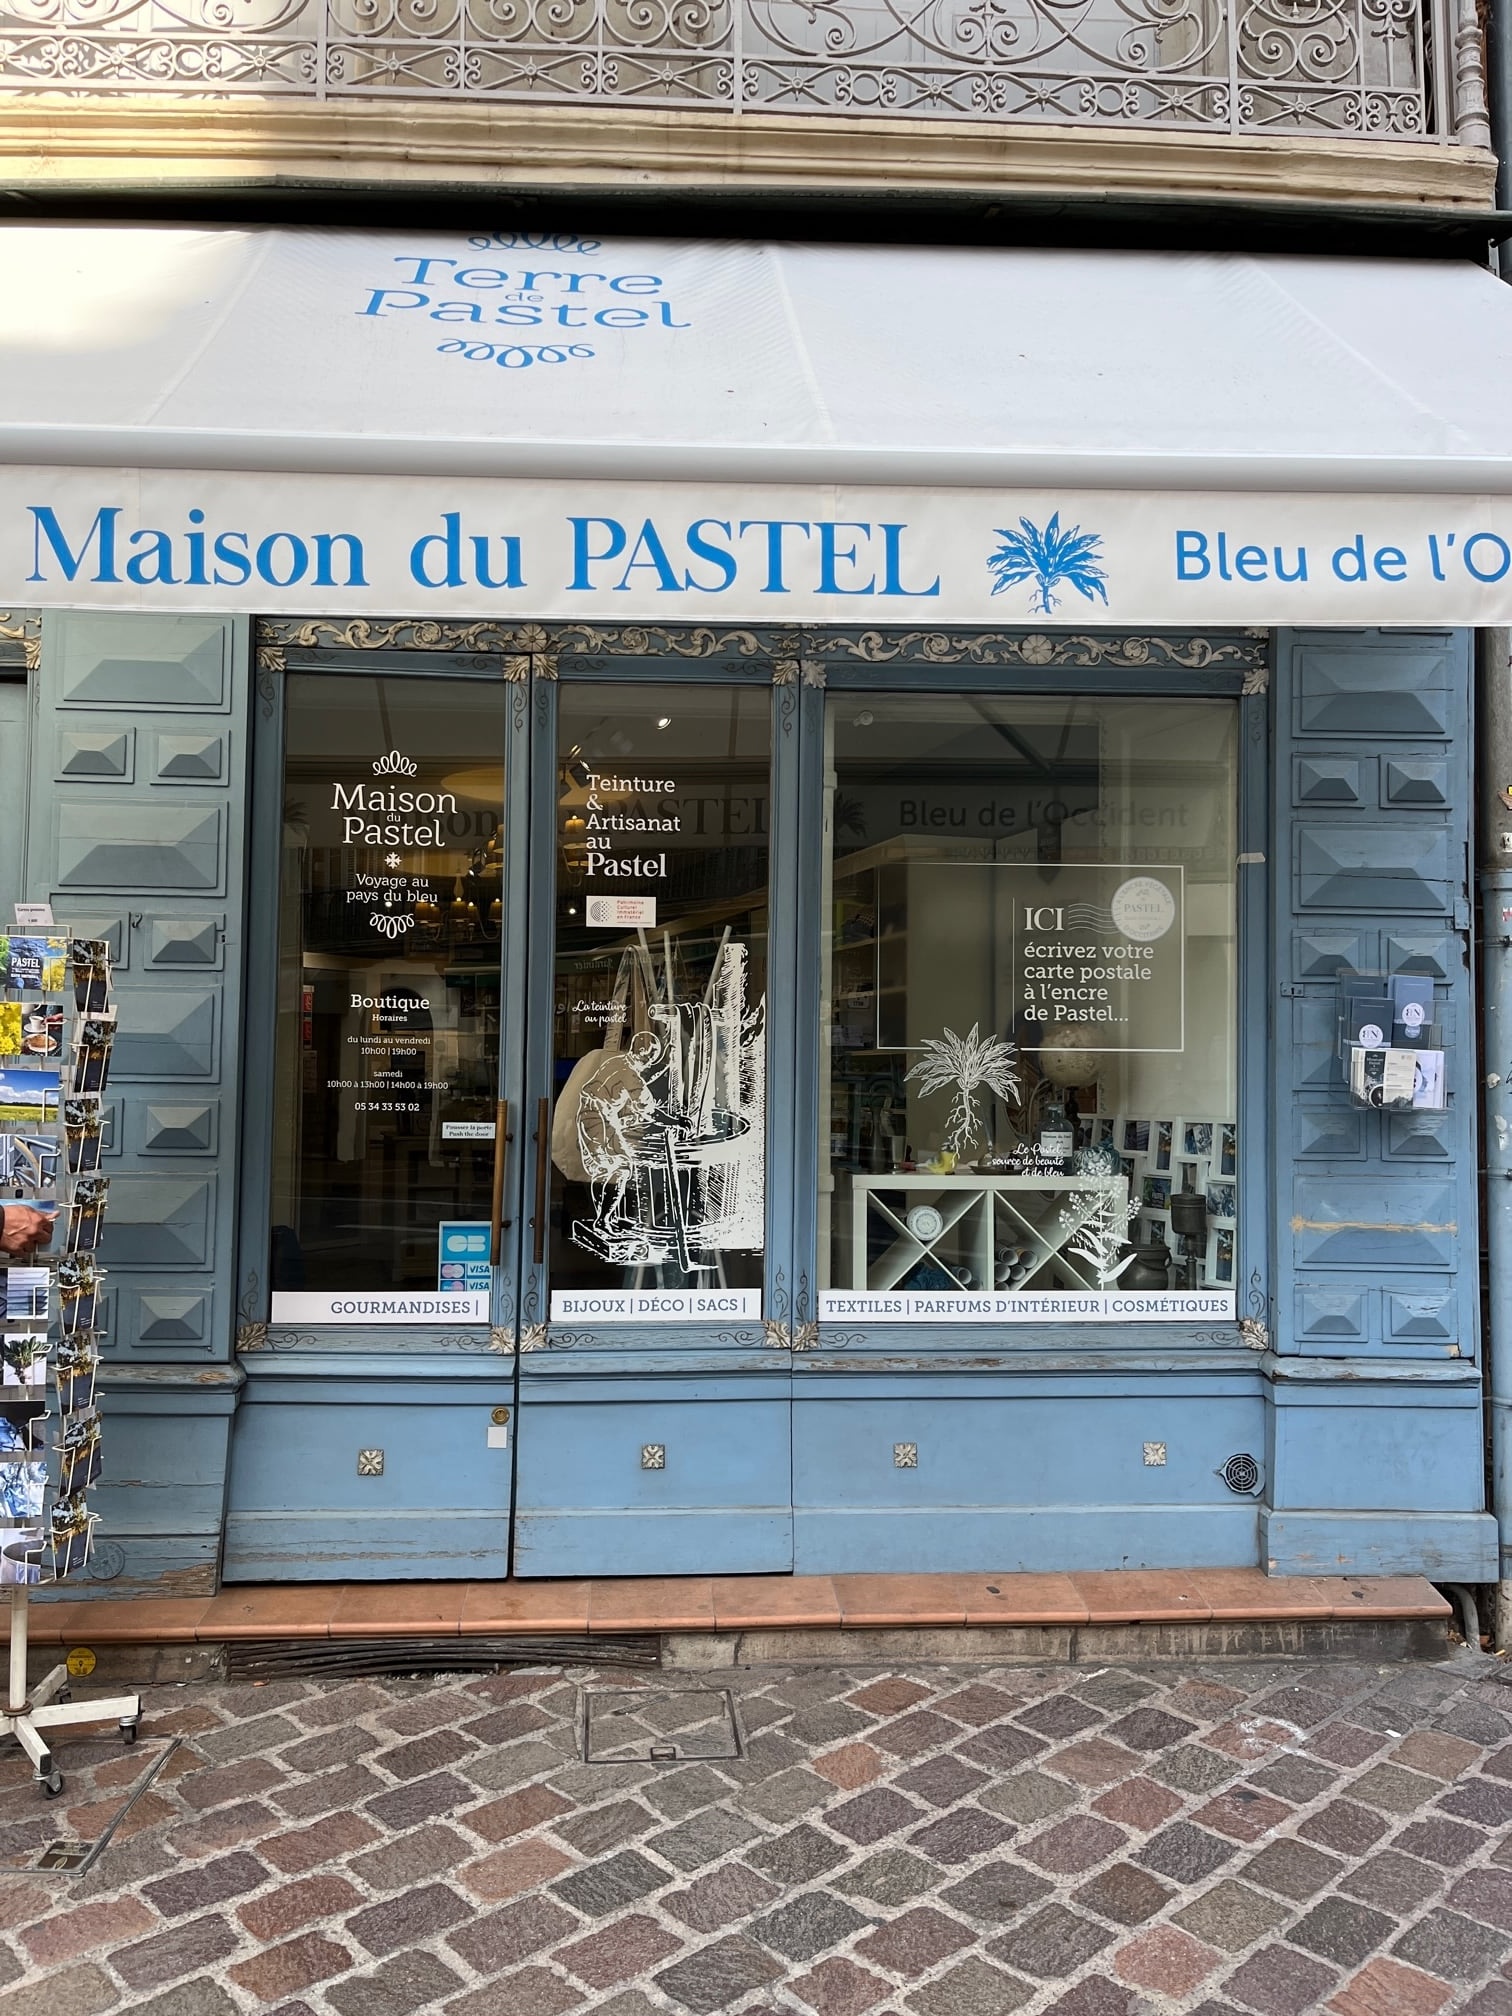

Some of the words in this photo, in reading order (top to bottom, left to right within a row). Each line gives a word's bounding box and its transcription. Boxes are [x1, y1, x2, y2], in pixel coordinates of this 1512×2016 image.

[394, 256, 662, 295] Terre
[504, 290, 545, 303] de
[354, 288, 692, 329] Pastel
[26, 506, 370, 587] Maison
[410, 511, 525, 590] du
[565, 517, 941, 598] PASTEL
[1176, 530, 1308, 582] Bleu
[1331, 534, 1408, 582] de
[586, 774, 676, 793] Teinture
[330, 782, 458, 814] Maison
[586, 793, 604, 811] &
[387, 812, 401, 822] du
[899, 800, 967, 827] Bleu
[978, 801, 1016, 827] de
[585, 813, 681, 832] Artisanat
[342, 816, 446, 847] Pastel
[586, 836, 612, 849] au
[585, 852, 668, 878] Pastel
[355, 873, 407, 890] Voyage
[411, 877, 429, 888] au
[346, 890, 379, 903] pays
[383, 889, 402, 902] du
[406, 890, 438, 903] bleu
[1124, 903, 1165, 913] PASTEL
[1023, 907, 1065, 931] ICI
[1024, 941, 1097, 959] écrivez
[1101, 944, 1154, 959] votre
[11, 957, 41, 968] PASTEL
[1024, 964, 1074, 979] carte
[1080, 964, 1152, 983] postale
[1024, 983, 1035, 1000] à
[1040, 984, 1108, 1000] l'encre
[350, 994, 430, 1012] Boutique
[572, 1000, 590, 1012] La
[591, 1000, 628, 1012] teinture
[372, 1013, 408, 1022] Horaires
[584, 1015, 599, 1023] au
[598, 1012, 628, 1028] pastel
[1024, 1005, 1048, 1021] de
[347, 1035, 358, 1044] du
[359, 1036, 382, 1044] lundi
[395, 1037, 431, 1045] vendredi
[360, 1047, 386, 1055] 10h00
[391, 1047, 417, 1056] 19h00
[373, 1070, 403, 1078] samedi
[326, 1080, 352, 1088] 10h00
[360, 1080, 385, 1089] 13h00
[391, 1081, 416, 1089] 14h00
[423, 1081, 449, 1090] 19h00
[354, 1102, 366, 1111] 05
[368, 1102, 380, 1111] 34
[381, 1102, 393, 1111] 33
[394, 1103, 406, 1111] 53
[407, 1103, 420, 1112] 02
[1013, 1142, 1030, 1155] Le
[992, 1157, 1021, 1166] source
[1022, 1155, 1035, 1166] de
[1035, 1156, 1065, 1166] beauté
[1021, 1168, 1031, 1177] et
[1031, 1166, 1043, 1177] de
[1043, 1166, 1065, 1177] bleu
[447, 1235, 486, 1253] CB
[470, 1265, 490, 1273] VISA
[469, 1282, 490, 1290] VISA
[331, 1301, 471, 1314] GOURMANDISES
[562, 1300, 625, 1312] BIJOUX
[638, 1296, 684, 1312] DÉCO
[697, 1299, 738, 1311] SACS
[826, 1300, 902, 1313] TEXTILES
[915, 1300, 991, 1313] PARFUMS
[996, 1297, 1100, 1313] D'INTÉRIEUR
[1112, 1297, 1229, 1313] COSMÉTIQUES
